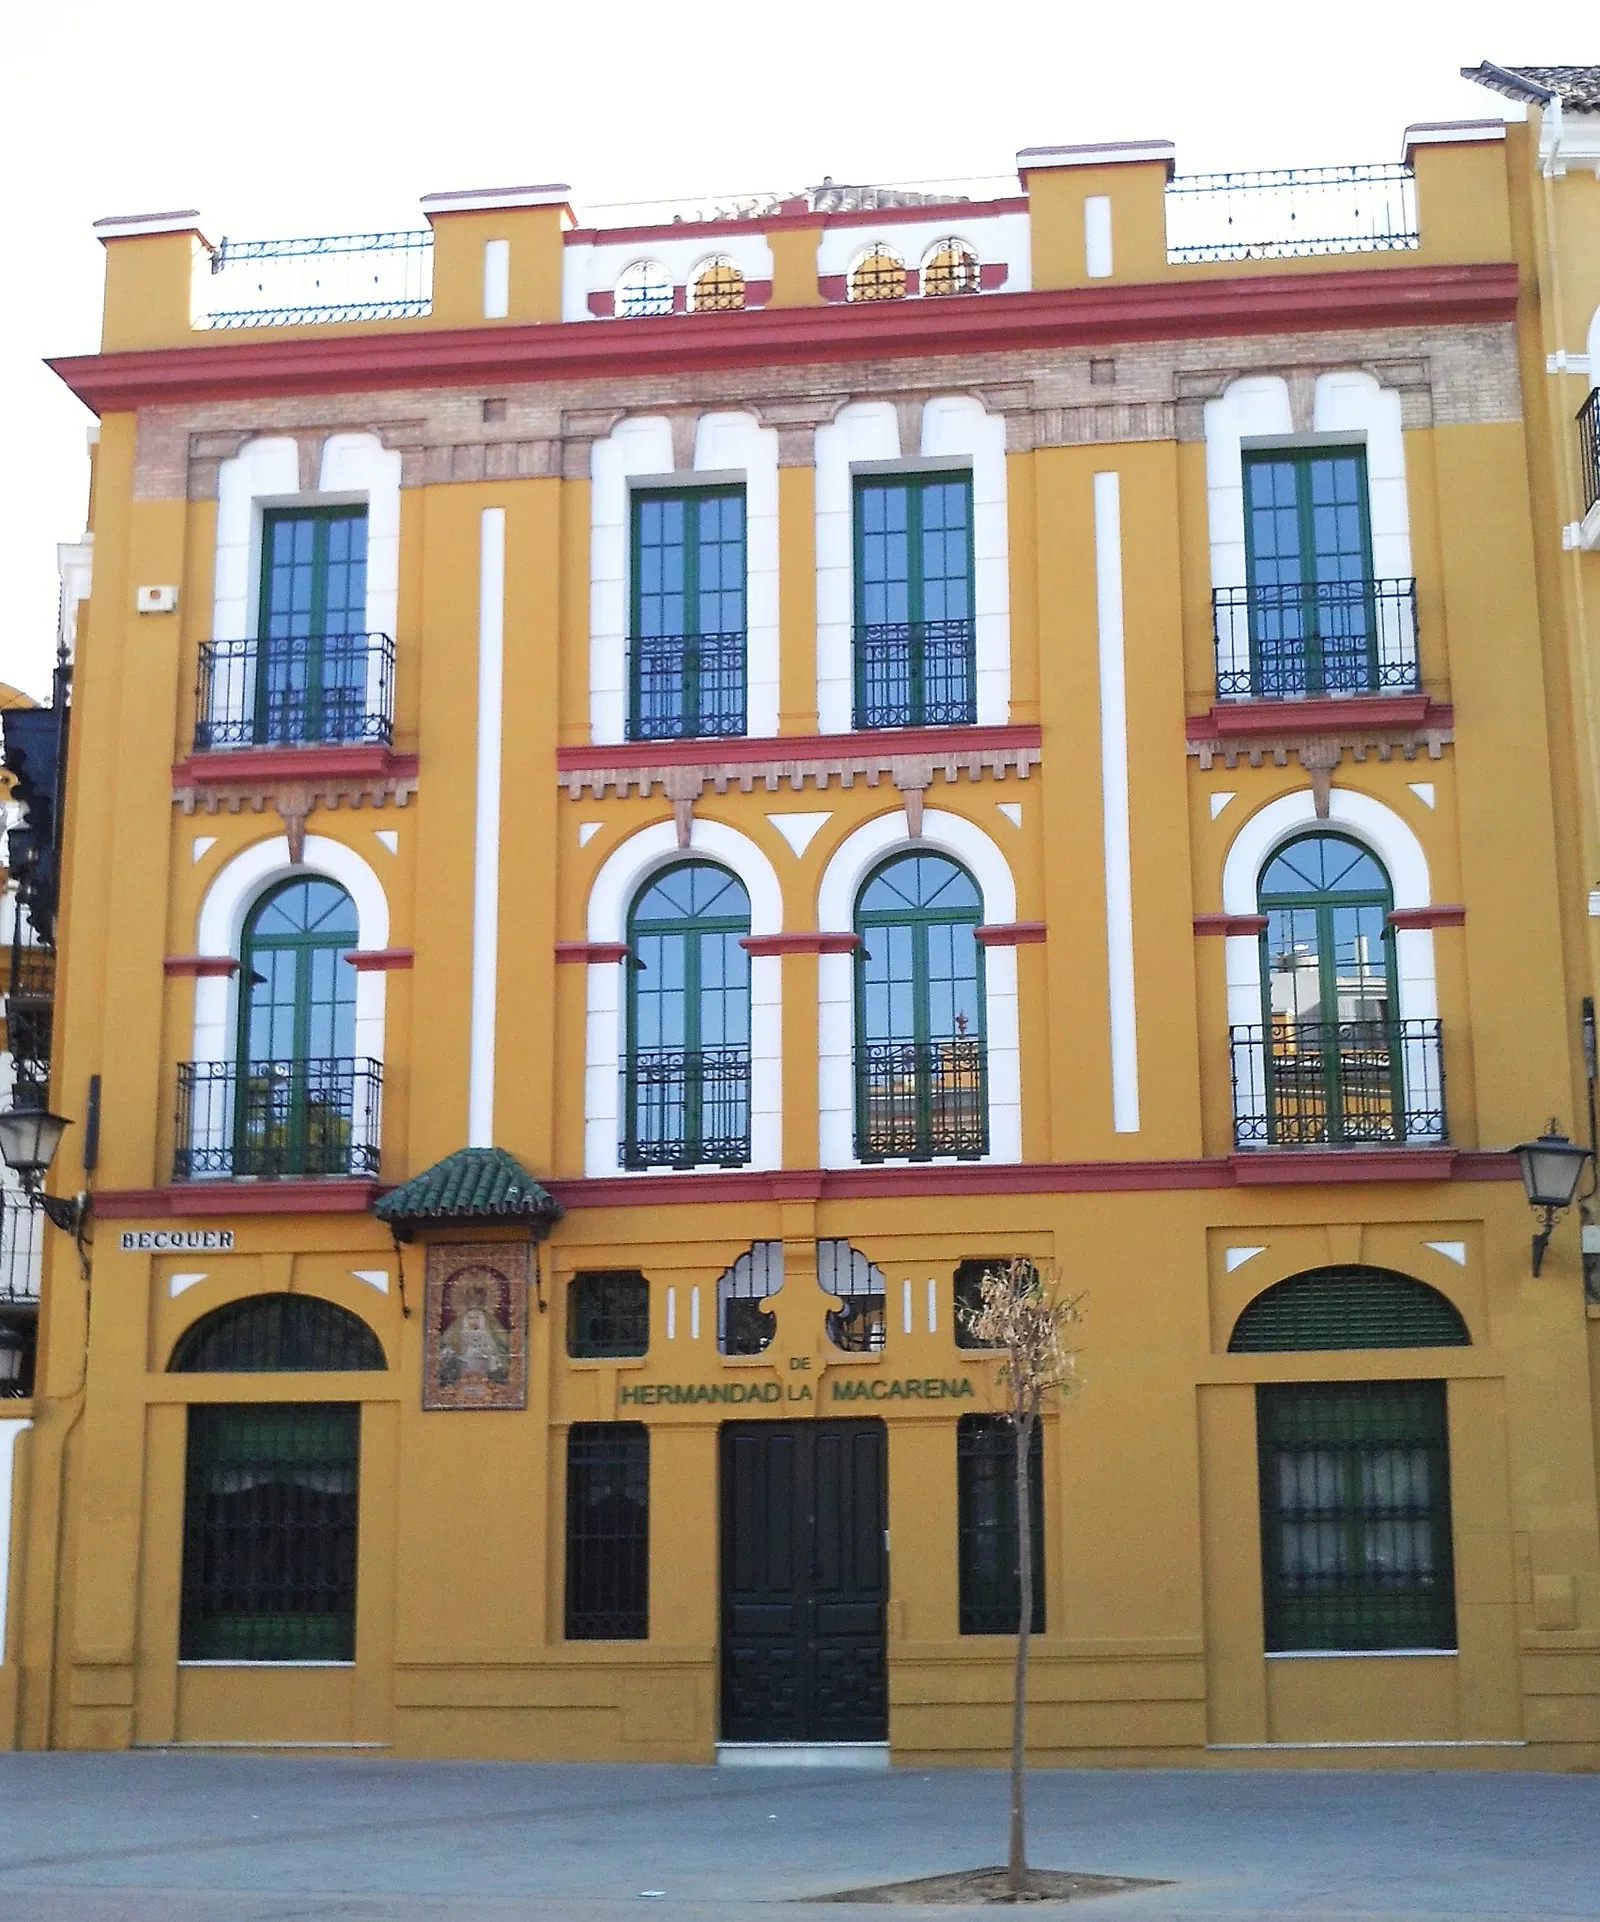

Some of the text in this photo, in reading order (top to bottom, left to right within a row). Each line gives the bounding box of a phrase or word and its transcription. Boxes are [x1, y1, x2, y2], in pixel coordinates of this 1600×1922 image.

[122, 1231, 233, 1248] BECQUER
[789, 1356, 811, 1371] DE
[621, 1378, 975, 1405] HERMANDAD LA MACARENA
